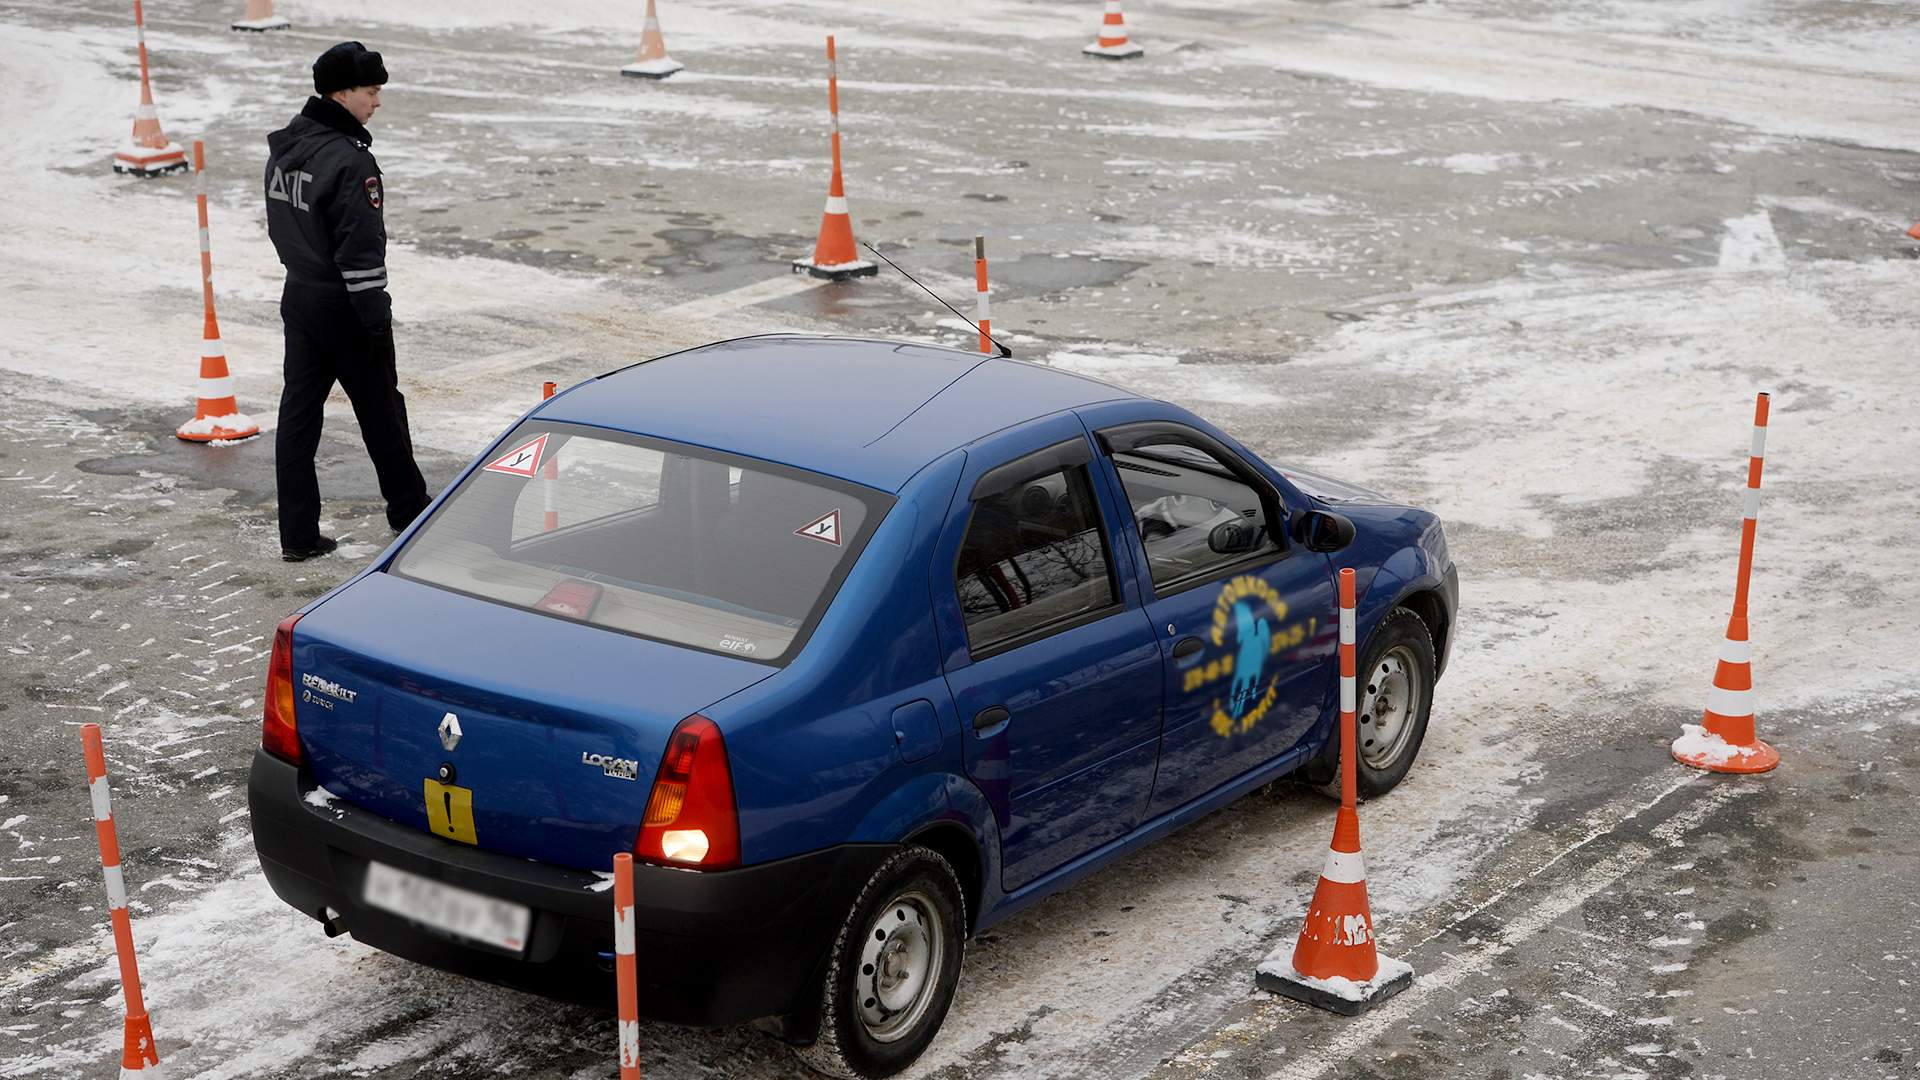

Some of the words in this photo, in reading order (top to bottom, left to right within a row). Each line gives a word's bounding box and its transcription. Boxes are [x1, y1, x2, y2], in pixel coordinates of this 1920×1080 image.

[268, 166, 313, 213] ДПС
[303, 673, 357, 704] RENAULT
[582, 751, 639, 774] LOGAN
